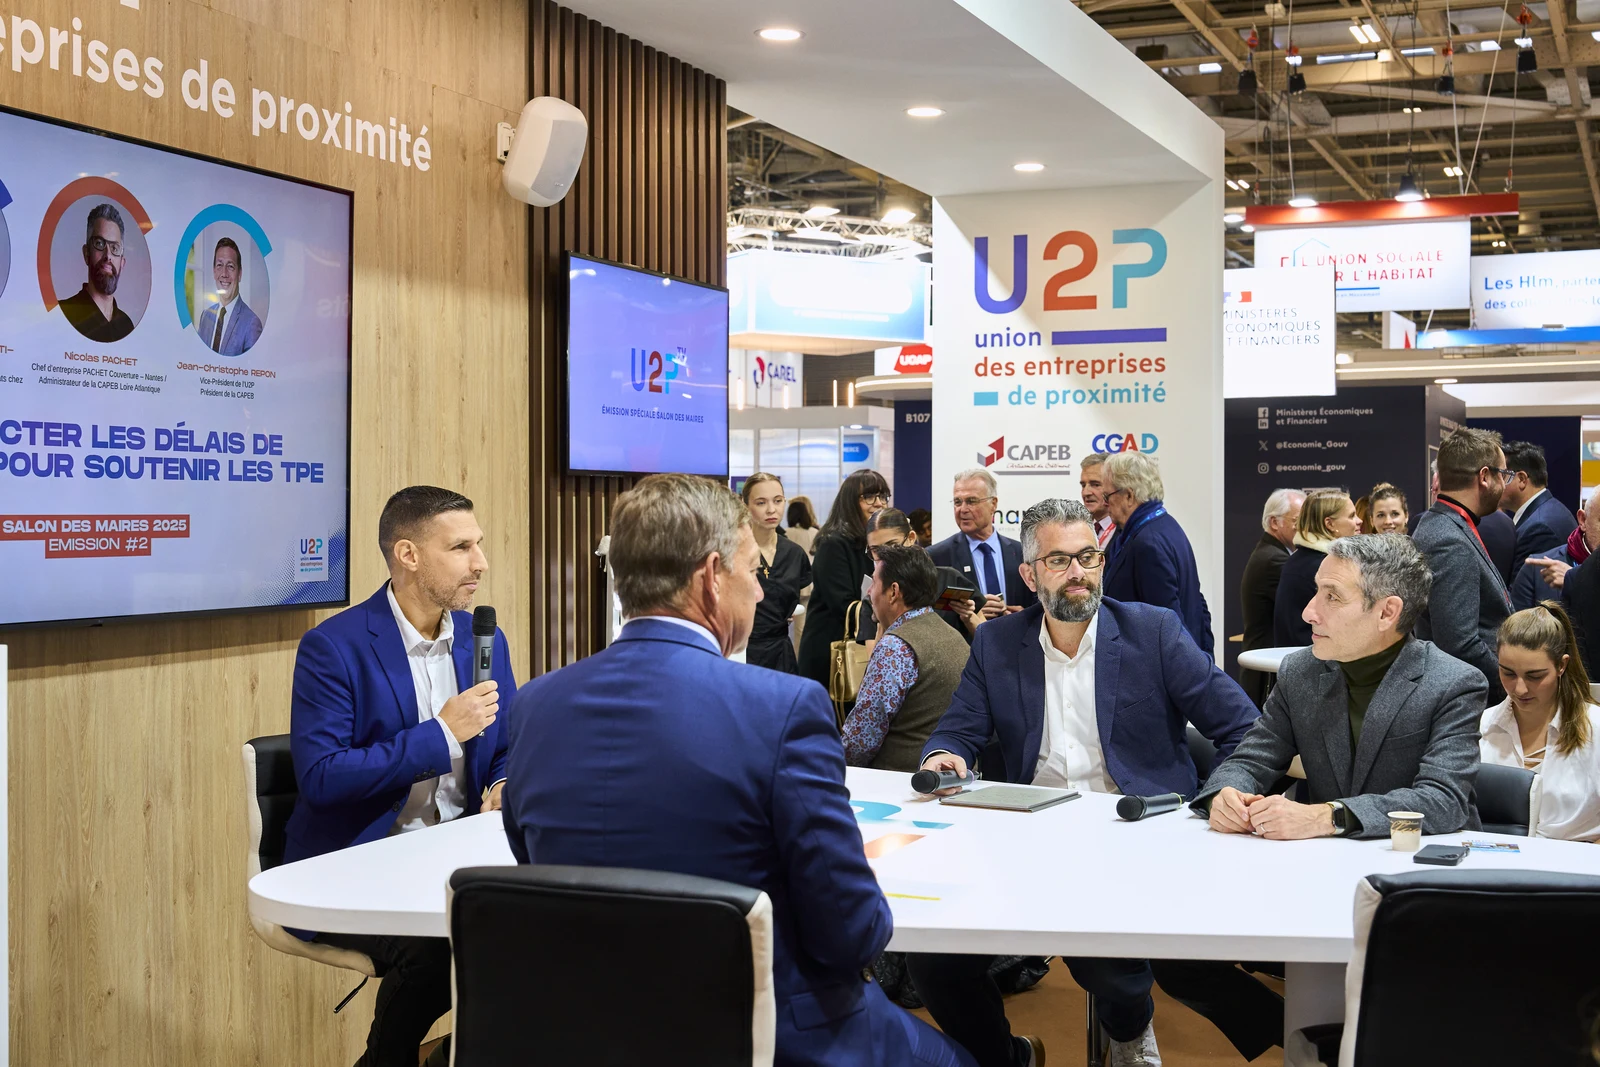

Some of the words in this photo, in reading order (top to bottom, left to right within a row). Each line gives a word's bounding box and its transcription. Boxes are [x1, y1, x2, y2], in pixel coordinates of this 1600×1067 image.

[0, 14, 165, 99] prises
[181, 59, 236, 118] de
[252, 87, 432, 172] proximité
[974, 227, 1168, 315] U2P
[1484, 276, 1514, 291] Les
[1484, 298, 1507, 310] des
[1225, 320, 1321, 334] CONOMIQUES
[974, 326, 1042, 348] union
[1238, 334, 1320, 346] FINANCIERS
[64, 351, 100, 363] Nicolas
[102, 355, 138, 366] PACHET
[974, 356, 1016, 377] des
[1024, 352, 1166, 379] entreprises
[31, 362, 46, 372] Chef
[48, 364, 82, 376] d'entreprise
[83, 368, 108, 377] PACHET
[109, 370, 139, 380] Couverture
[144, 374, 164, 382] Nantes
[176, 361, 248, 376] Jean-Christophe
[250, 369, 276, 378] REPON
[631, 348, 679, 394] U2P
[767, 362, 797, 383] CAREL
[8, 374, 24, 384] chez
[38, 376, 81, 387] Administrateur
[82, 380, 90, 388] de
[90, 380, 96, 388] la
[98, 381, 118, 390] CAPEB
[120, 382, 134, 392] Loire
[134, 382, 160, 394] Atlantique
[235, 380, 242, 388] de
[200, 388, 224, 398] Président
[224, 390, 230, 398] de
[231, 390, 236, 398] la
[236, 391, 254, 400] CAPEB
[1008, 384, 1037, 406] de
[1046, 381, 1167, 410] proximité
[602, 404, 630, 417] ÉMISSION
[630, 408, 656, 420] SPÉCIALE
[656, 410, 674, 421] SALON
[674, 413, 685, 422] DES
[686, 414, 704, 424] MAIRES
[906, 412, 931, 424] B107
[1276, 408, 1318, 416] Ministères
[1320, 406, 1374, 416] Économiques
[1286, 416, 1328, 426] Financiers
[92, 424, 146, 450] LES
[154, 420, 246, 454] DÉLAIS
[252, 434, 283, 456] DE
[1092, 432, 1159, 454] CGAD
[1276, 440, 1348, 450] @Economie_Gouv
[1007, 444, 1072, 461] CAPEB
[84, 454, 220, 482] SOUTENIR
[228, 460, 274, 482] LES
[280, 462, 324, 484] TPE
[1276, 462, 1346, 473] @economie_gouv
[2, 520, 57, 534] SALON
[61, 520, 92, 533] DES
[96, 520, 149, 532] MAIRES
[153, 519, 187, 532] 2025
[48, 538, 120, 552] EMISSION
[125, 536, 148, 552] #2
[300, 538, 323, 554] U2P
